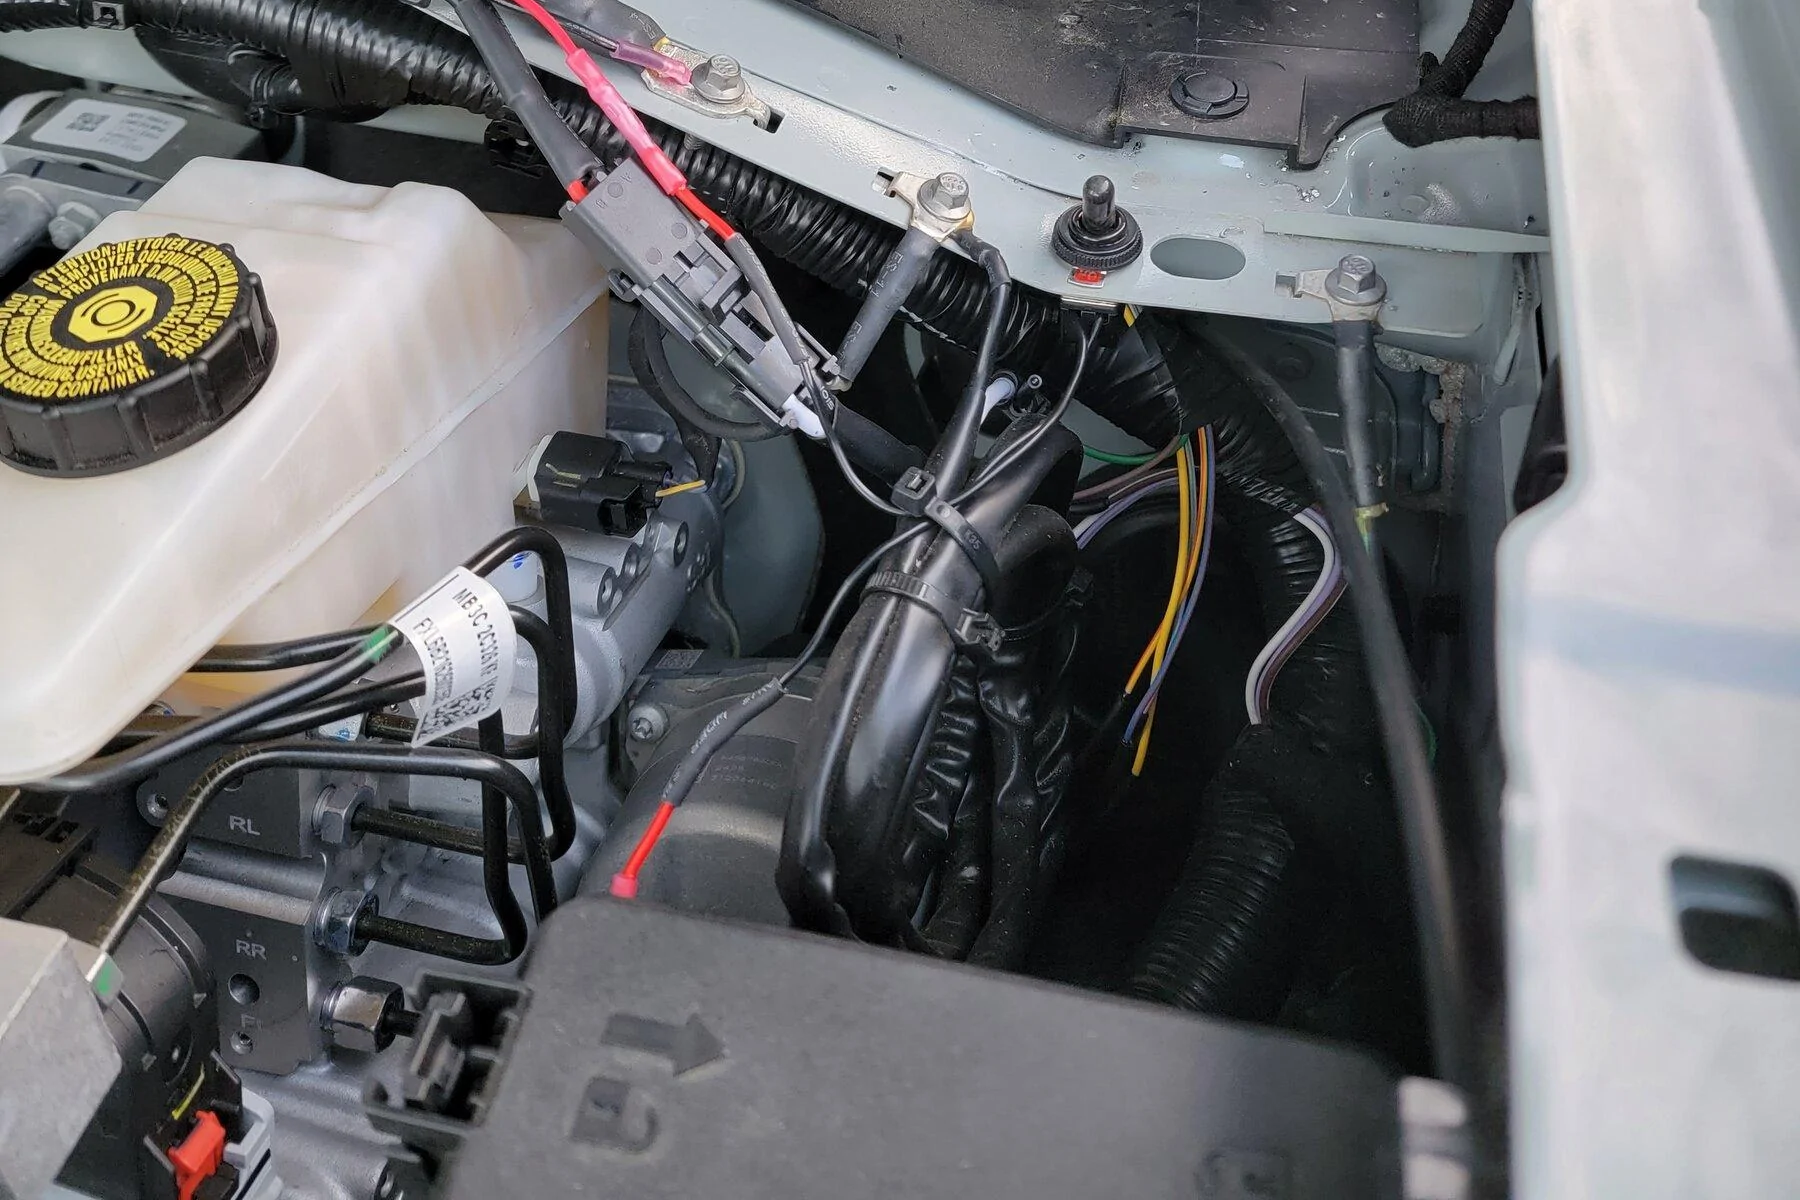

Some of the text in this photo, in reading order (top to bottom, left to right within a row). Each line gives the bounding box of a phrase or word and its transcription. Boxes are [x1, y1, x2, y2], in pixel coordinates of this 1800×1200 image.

[58, 263, 149, 300] PROVENANT
[229, 815, 261, 836] RL
[235, 938, 267, 961] RR
